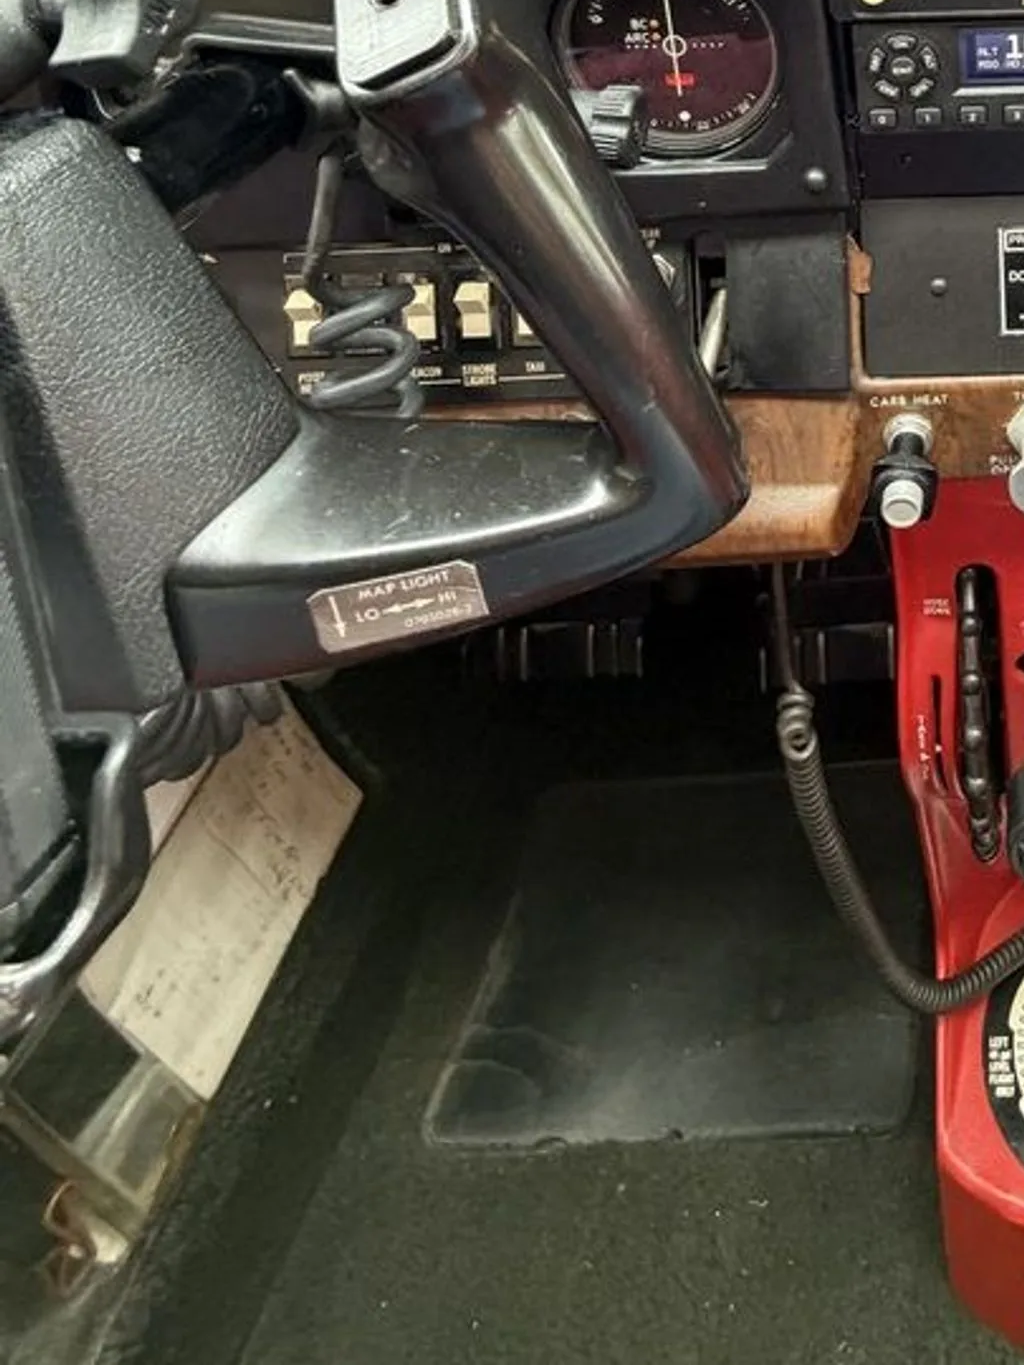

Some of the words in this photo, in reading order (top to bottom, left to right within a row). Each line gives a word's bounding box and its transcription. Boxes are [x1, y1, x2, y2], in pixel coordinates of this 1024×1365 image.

[869, 395, 907, 409] CARB
[912, 393, 950, 407] HEAT
[358, 583, 396, 601] MAP
[401, 570, 451, 592] LIGHT
[437, 590, 458, 606] HI
[354, 608, 381, 624] LO
